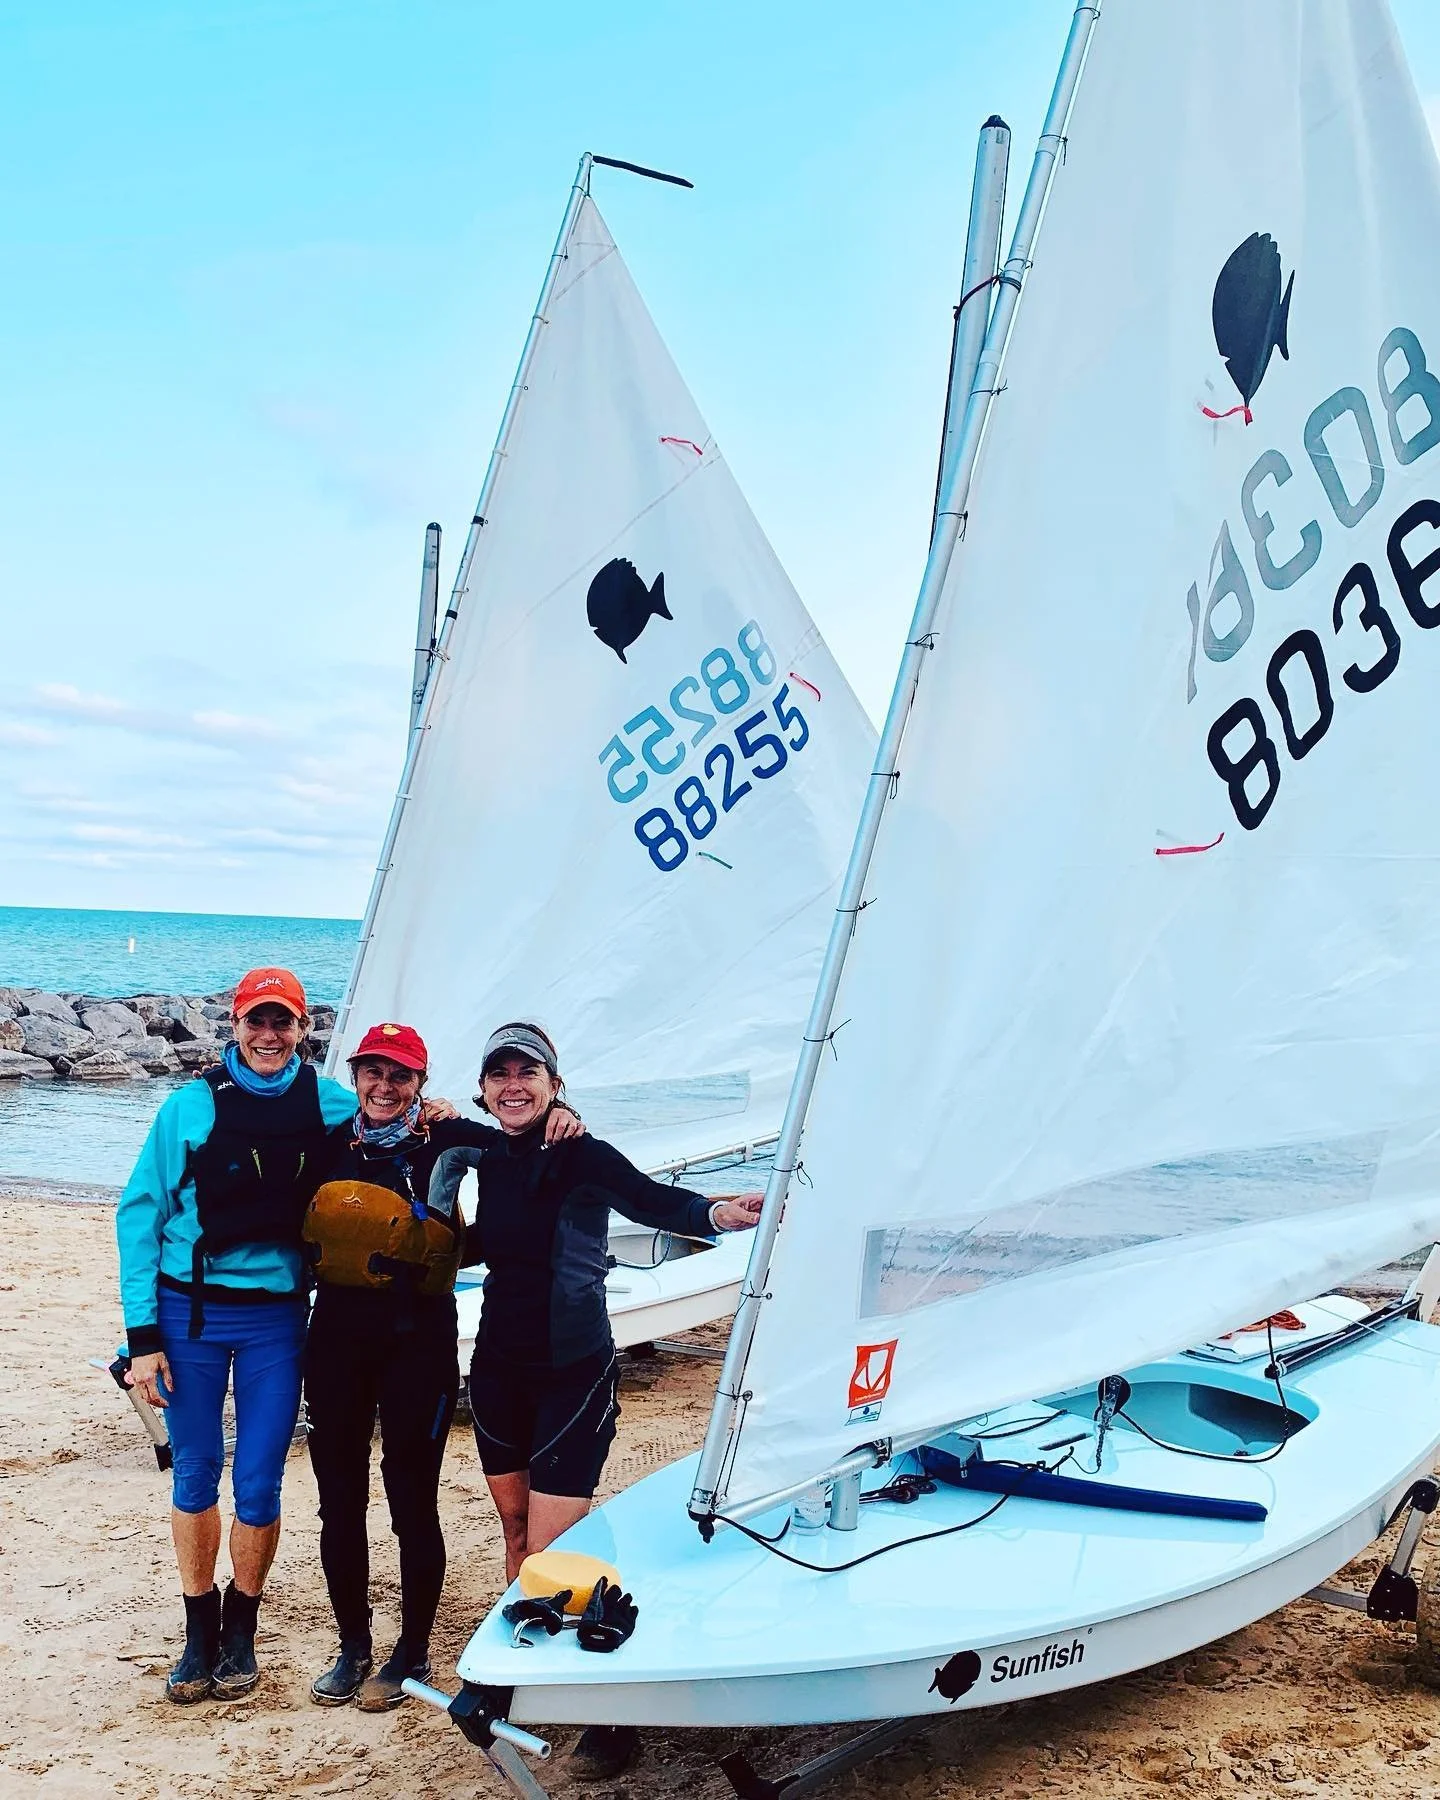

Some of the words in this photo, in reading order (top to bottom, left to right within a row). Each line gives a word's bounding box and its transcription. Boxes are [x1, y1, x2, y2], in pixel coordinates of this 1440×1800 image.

[1207, 499, 1440, 830] 8036
[634, 683, 809, 872] 88255
[990, 1639, 1085, 1683] Sunfish
